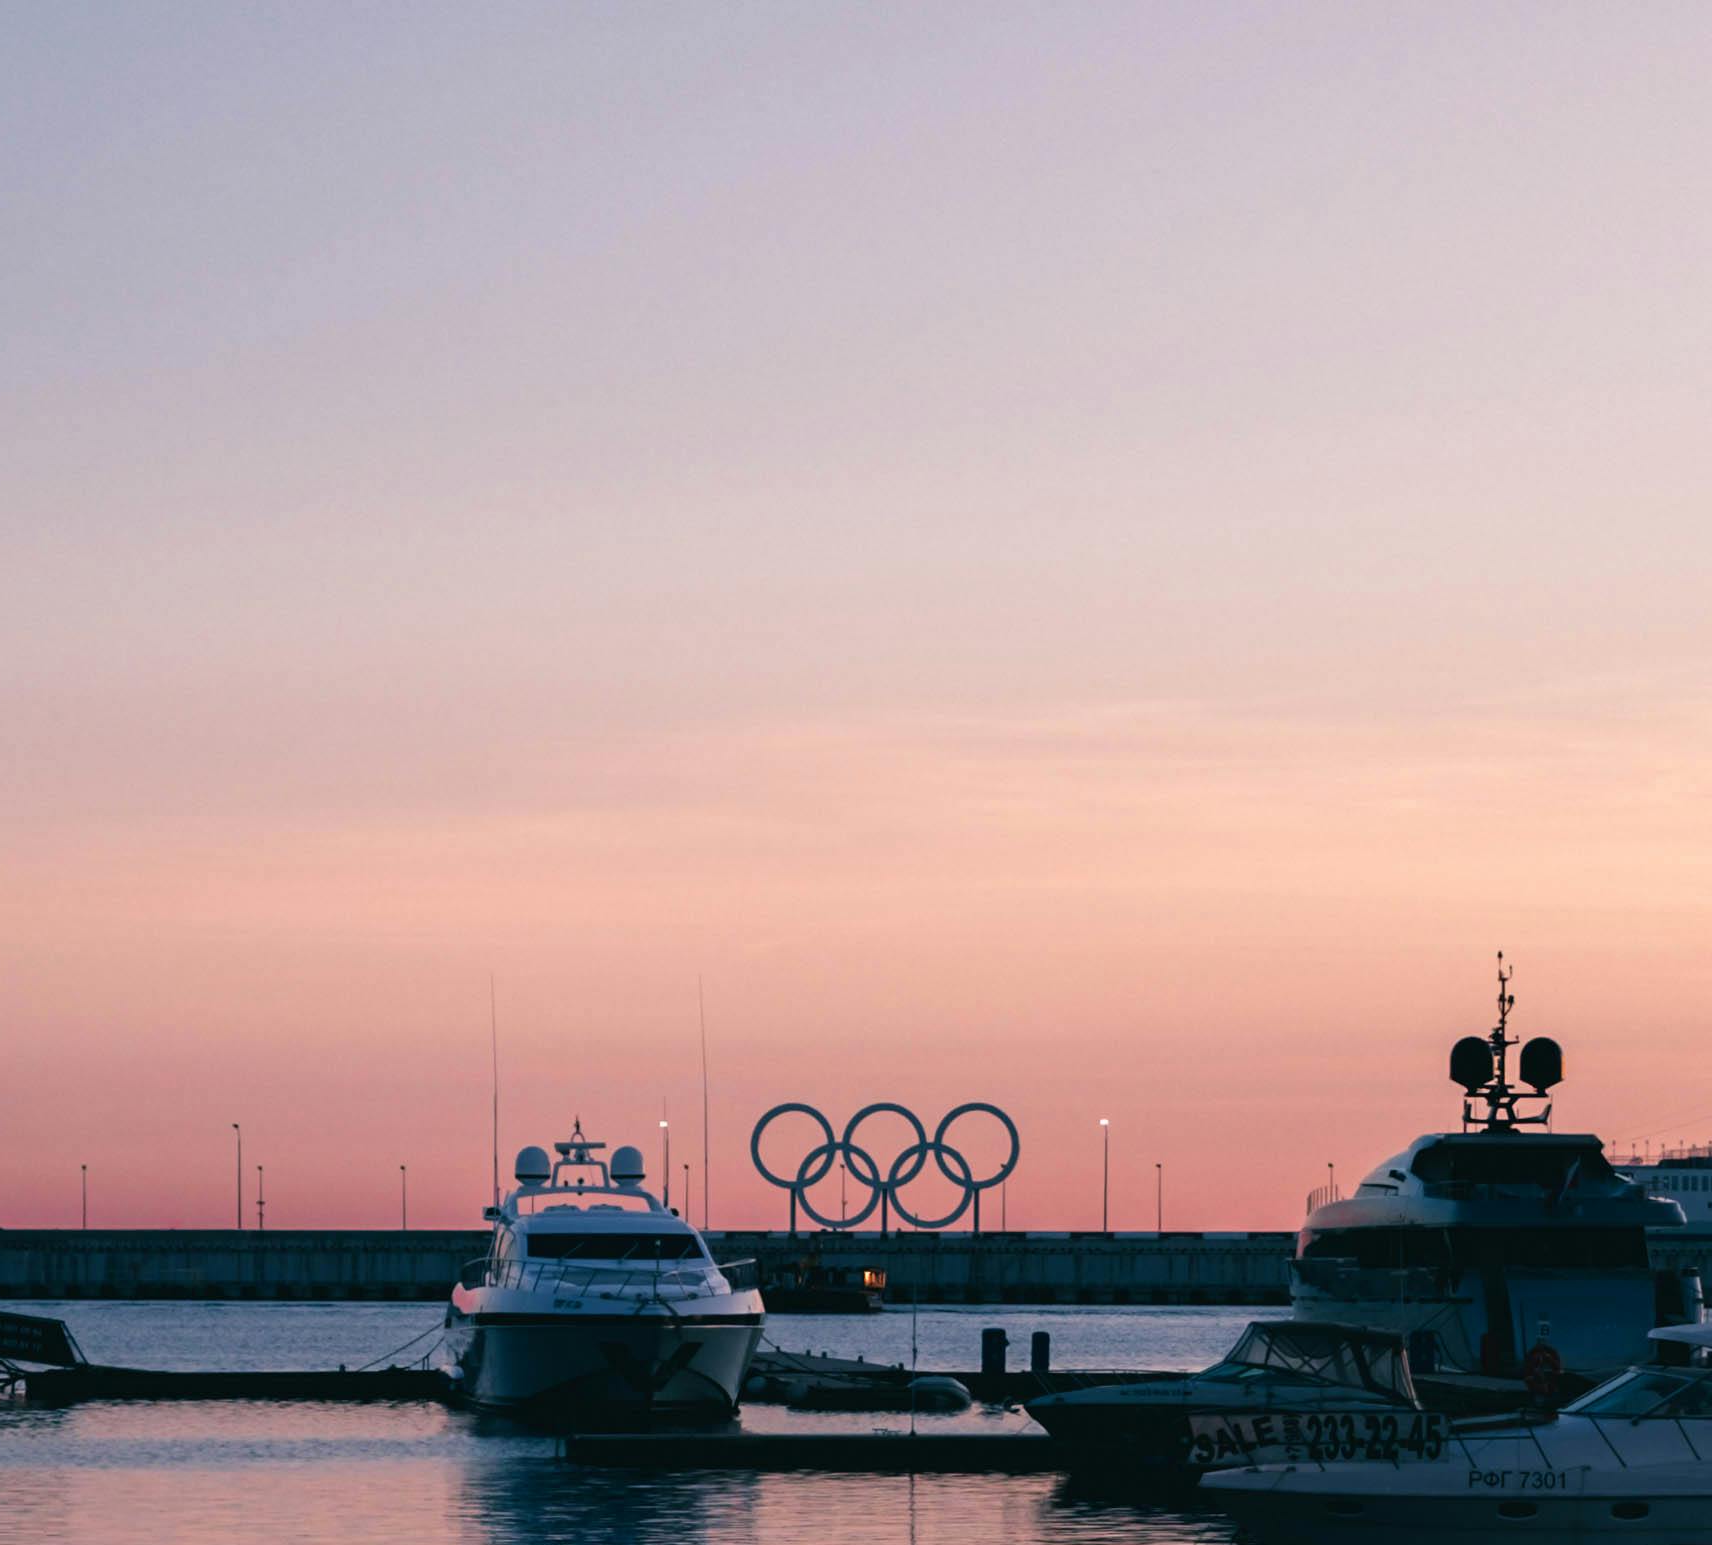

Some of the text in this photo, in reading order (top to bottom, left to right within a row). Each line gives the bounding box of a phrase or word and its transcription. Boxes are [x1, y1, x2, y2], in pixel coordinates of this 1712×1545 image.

[1192, 1416, 1279, 1464] SALE
[1307, 1415, 1441, 1461] 233-22-45
[1468, 1471, 1566, 1489] РФГ 7301
